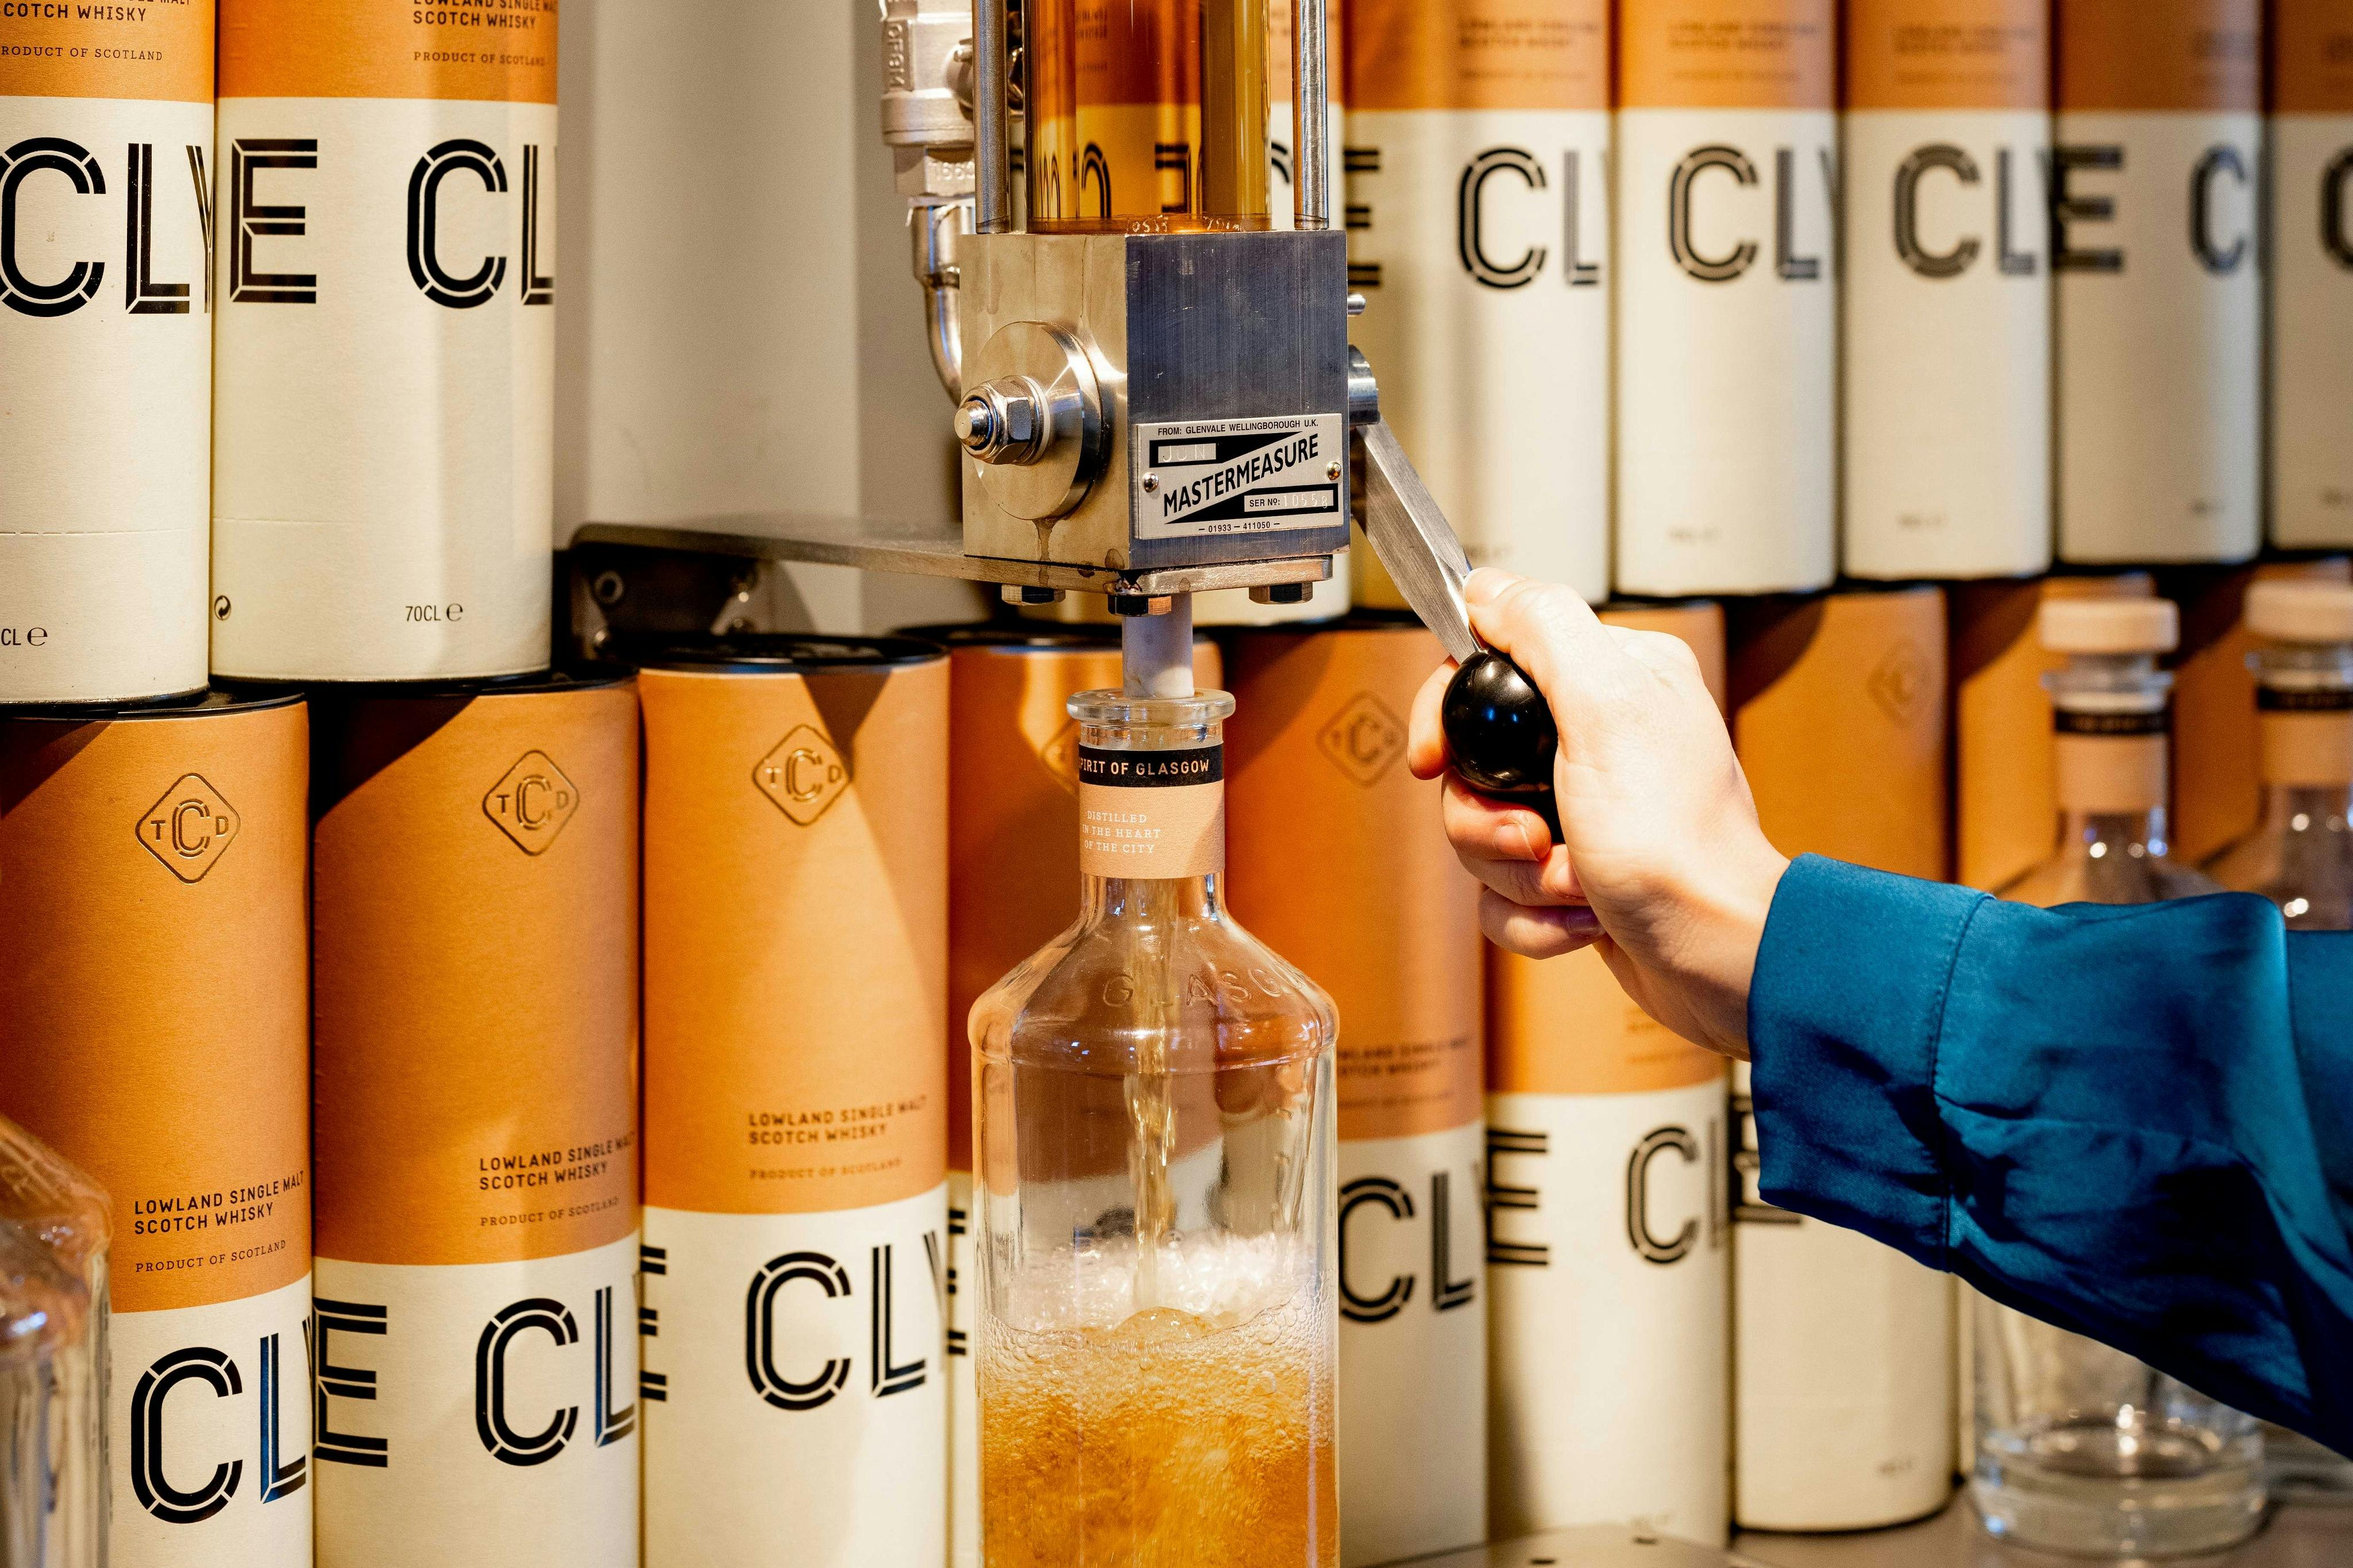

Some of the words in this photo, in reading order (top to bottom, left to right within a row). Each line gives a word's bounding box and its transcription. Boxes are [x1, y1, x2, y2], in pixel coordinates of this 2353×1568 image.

[0, 2, 68, 18] COTCH
[77, 5, 146, 21] WHISKY
[413, 10, 480, 26] SCOTCH
[486, 13, 536, 29] WHISKY
[70, 48, 88, 58] OF
[94, 48, 163, 61] SCOTLAND
[413, 51, 477, 63] PRODUCT
[480, 53, 495, 64] OF
[1158, 427, 1182, 436] FROM:
[1185, 424, 1226, 434] GLENVALE
[1229, 420, 1301, 431] WELLINGBOROUGH
[1303, 419, 1319, 427] U.K.
[1163, 433, 1319, 517] MASTERMEASURE
[1249, 499, 1266, 508] SER
[1208, 524, 1232, 534] 01933
[1243, 521, 1271, 531] 411050
[404, 605, 442, 623] 70CL
[1110, 762, 1129, 775] OF
[1136, 759, 1209, 775] GLASGOW
[1087, 810, 1147, 824] DISTILLED
[1082, 824, 1089, 833] IN
[1091, 826, 1111, 836] THE
[1115, 828, 1162, 839] HEART
[1084, 840, 1093, 849] OF
[1096, 842, 1117, 852] THE
[1123, 844, 1155, 853] CITY
[748, 1110, 834, 1127] LOWLAND
[748, 1130, 819, 1145] SCOTCH
[479, 1151, 562, 1171] LOWLAND
[568, 1140, 612, 1163] SINGLE
[479, 1171, 548, 1190] SCOTCH
[553, 1161, 607, 1183] WHISKY
[134, 1193, 223, 1215] LOWLAND
[229, 1180, 279, 1204] SINGLE
[283, 1171, 304, 1192] MALT
[134, 1214, 207, 1235] SCOTCH
[215, 1202, 273, 1226] WHISKY
[480, 1212, 544, 1226] PRODUCT
[548, 1208, 565, 1221] OF
[136, 1257, 203, 1273] PRODUCT
[209, 1254, 226, 1265] OF
[231, 1239, 286, 1261] SCOTLAND
